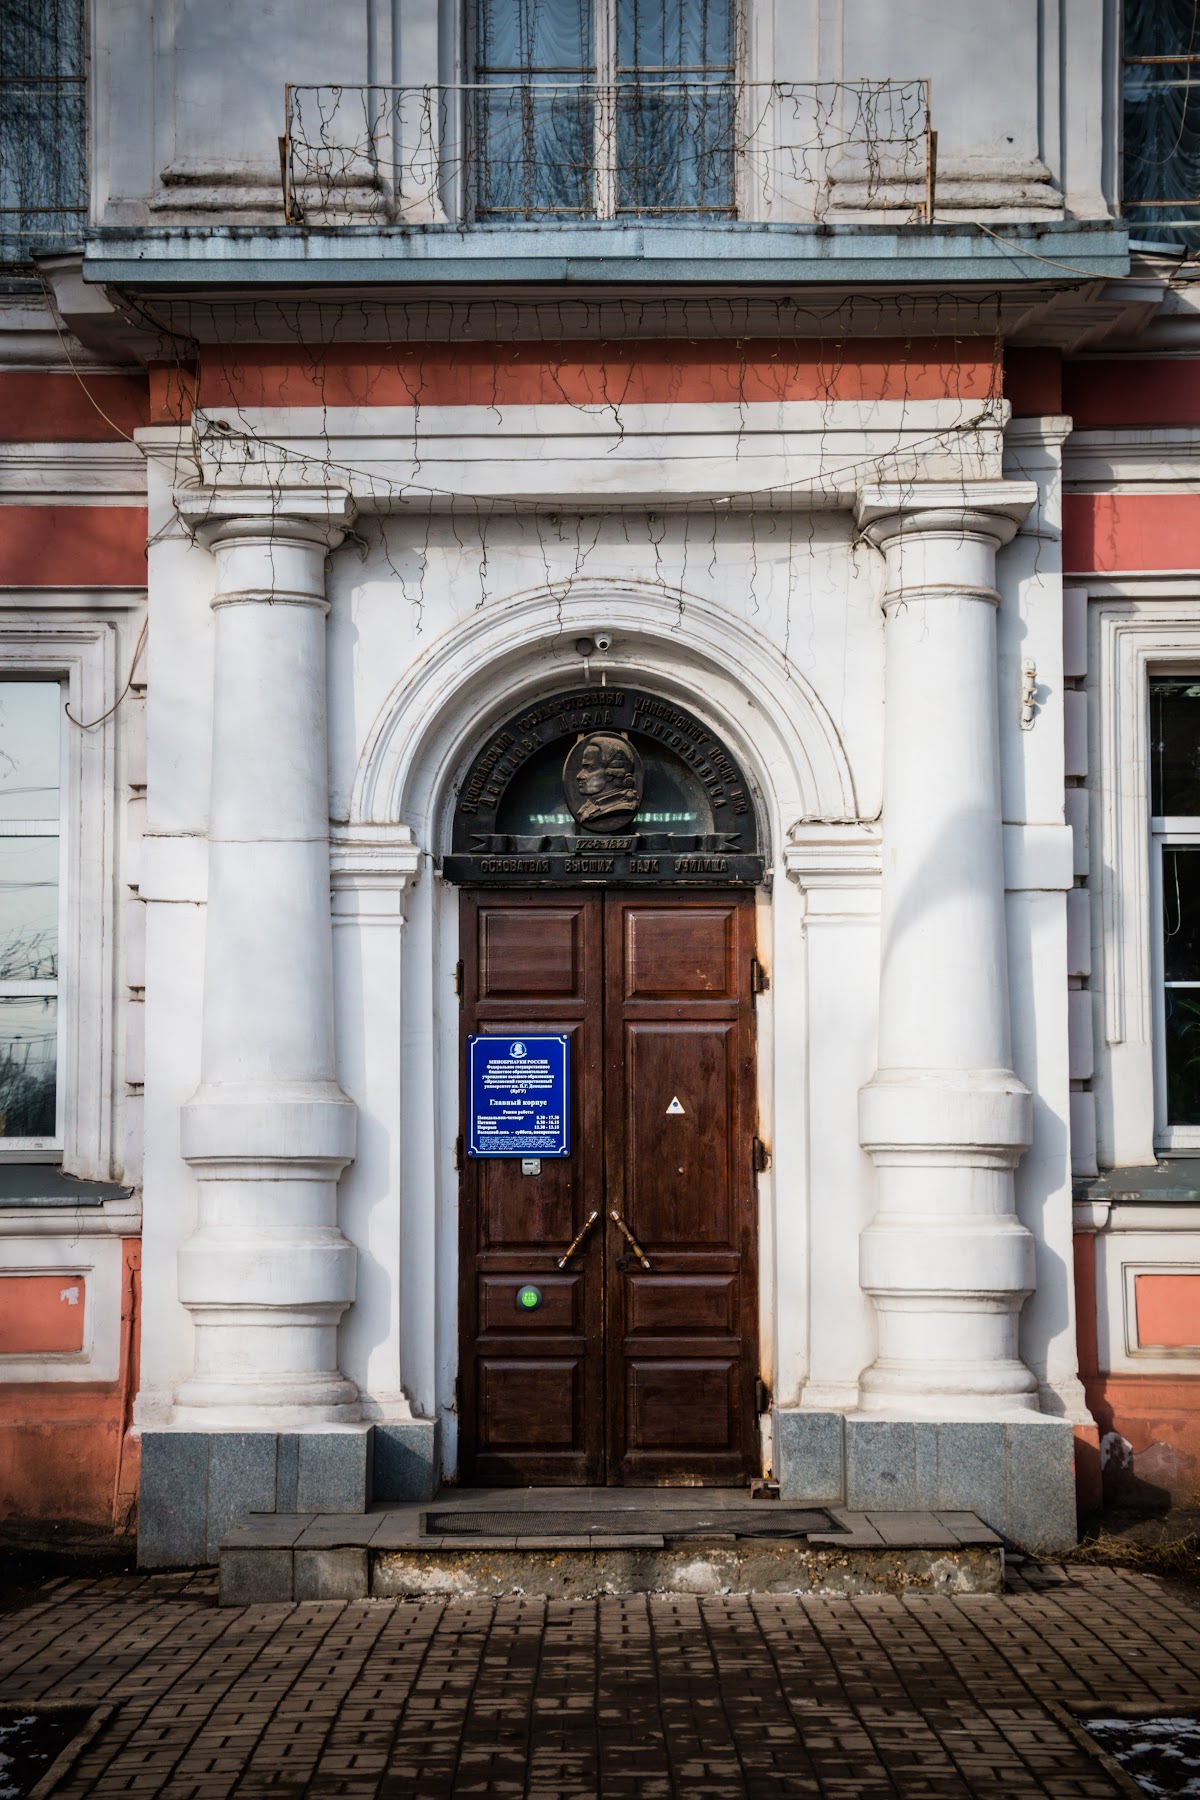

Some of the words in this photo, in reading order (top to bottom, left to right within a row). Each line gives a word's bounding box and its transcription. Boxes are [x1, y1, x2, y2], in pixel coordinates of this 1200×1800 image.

[480, 859, 549, 873] ОСНОВАТЕЛЯ
[564, 859, 614, 873] ВЫСШИХ
[629, 859, 659, 873] НАУК
